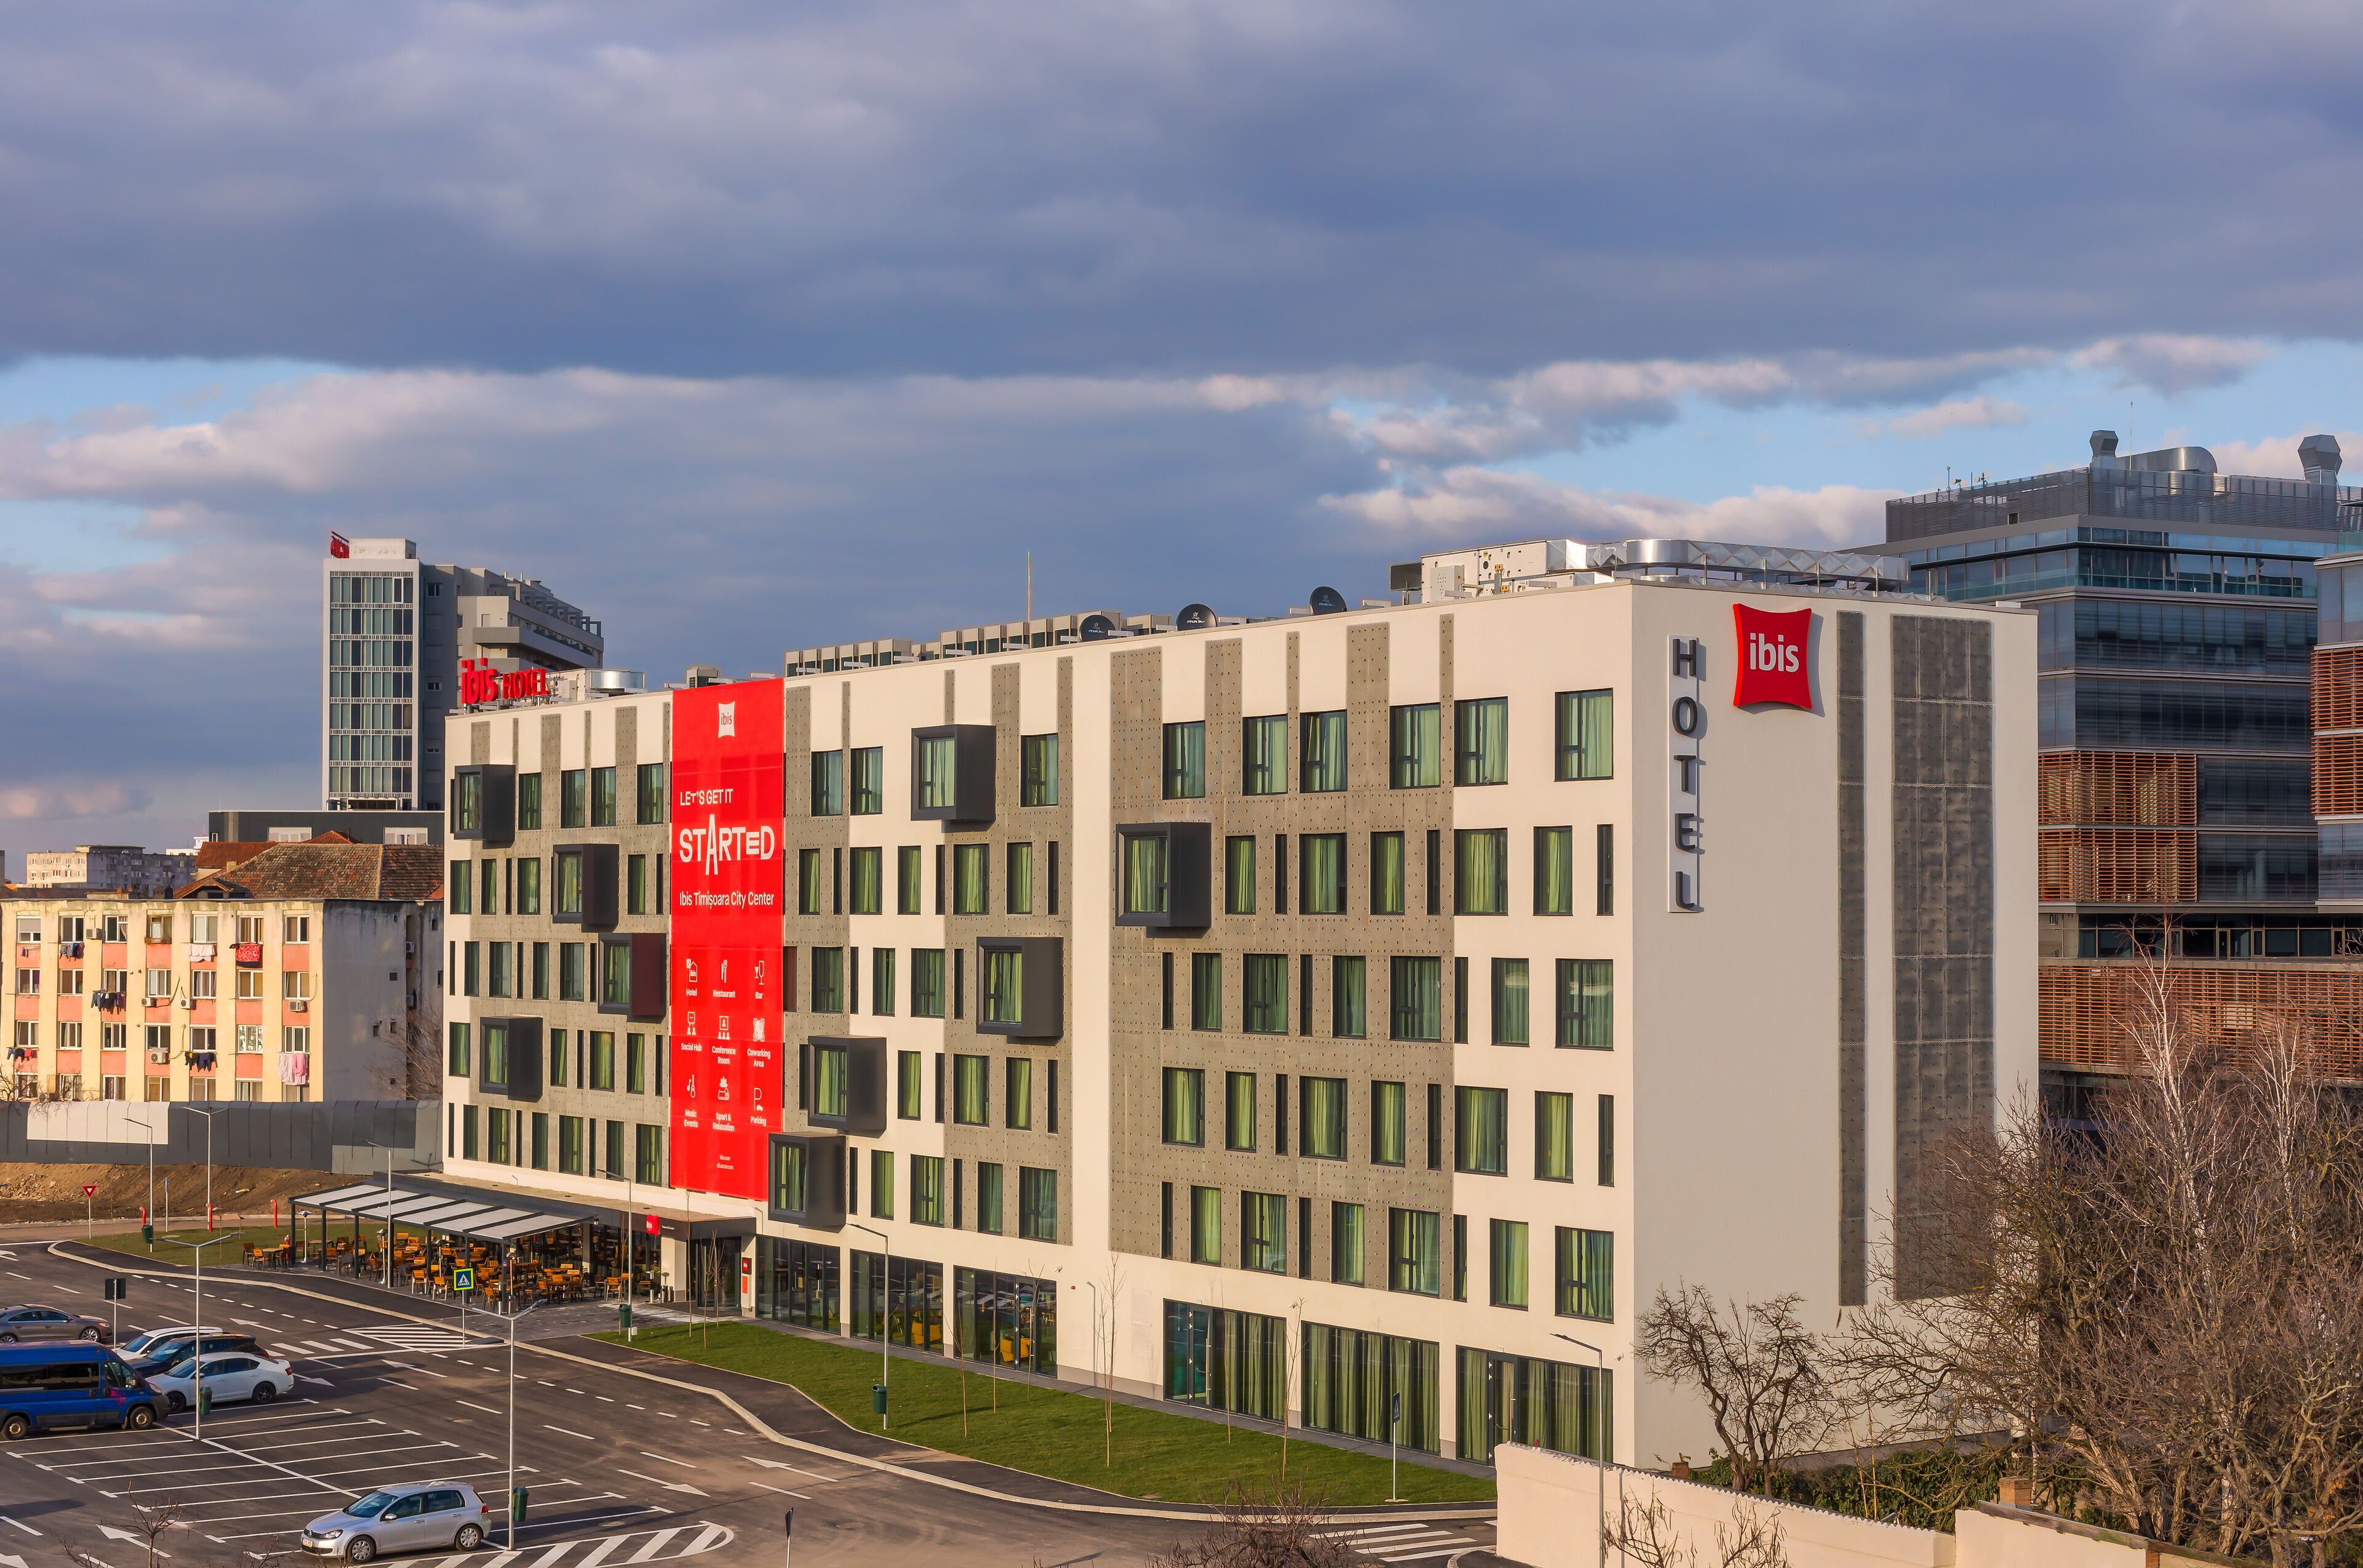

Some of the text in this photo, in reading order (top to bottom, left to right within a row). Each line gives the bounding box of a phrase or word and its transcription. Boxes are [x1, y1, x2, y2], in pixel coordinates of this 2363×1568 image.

[1749, 633, 1800, 673] ibis
[461, 657, 551, 704] ibis HOTEL
[721, 712, 732, 725] ibis
[1672, 638, 1698, 909] HOTEL
[681, 789, 733, 806] LET'S GET IT
[679, 814, 775, 875] STARTED
[680, 890, 774, 910] Ibis Timișoara City Center
[712, 1046, 736, 1055] Conference
[747, 1049, 770, 1059] Coworking
[685, 1110, 697, 1118] Music
[684, 1119, 698, 1127] Events
[713, 1122, 734, 1132] Relaxation
[751, 1116, 766, 1127] Parking
